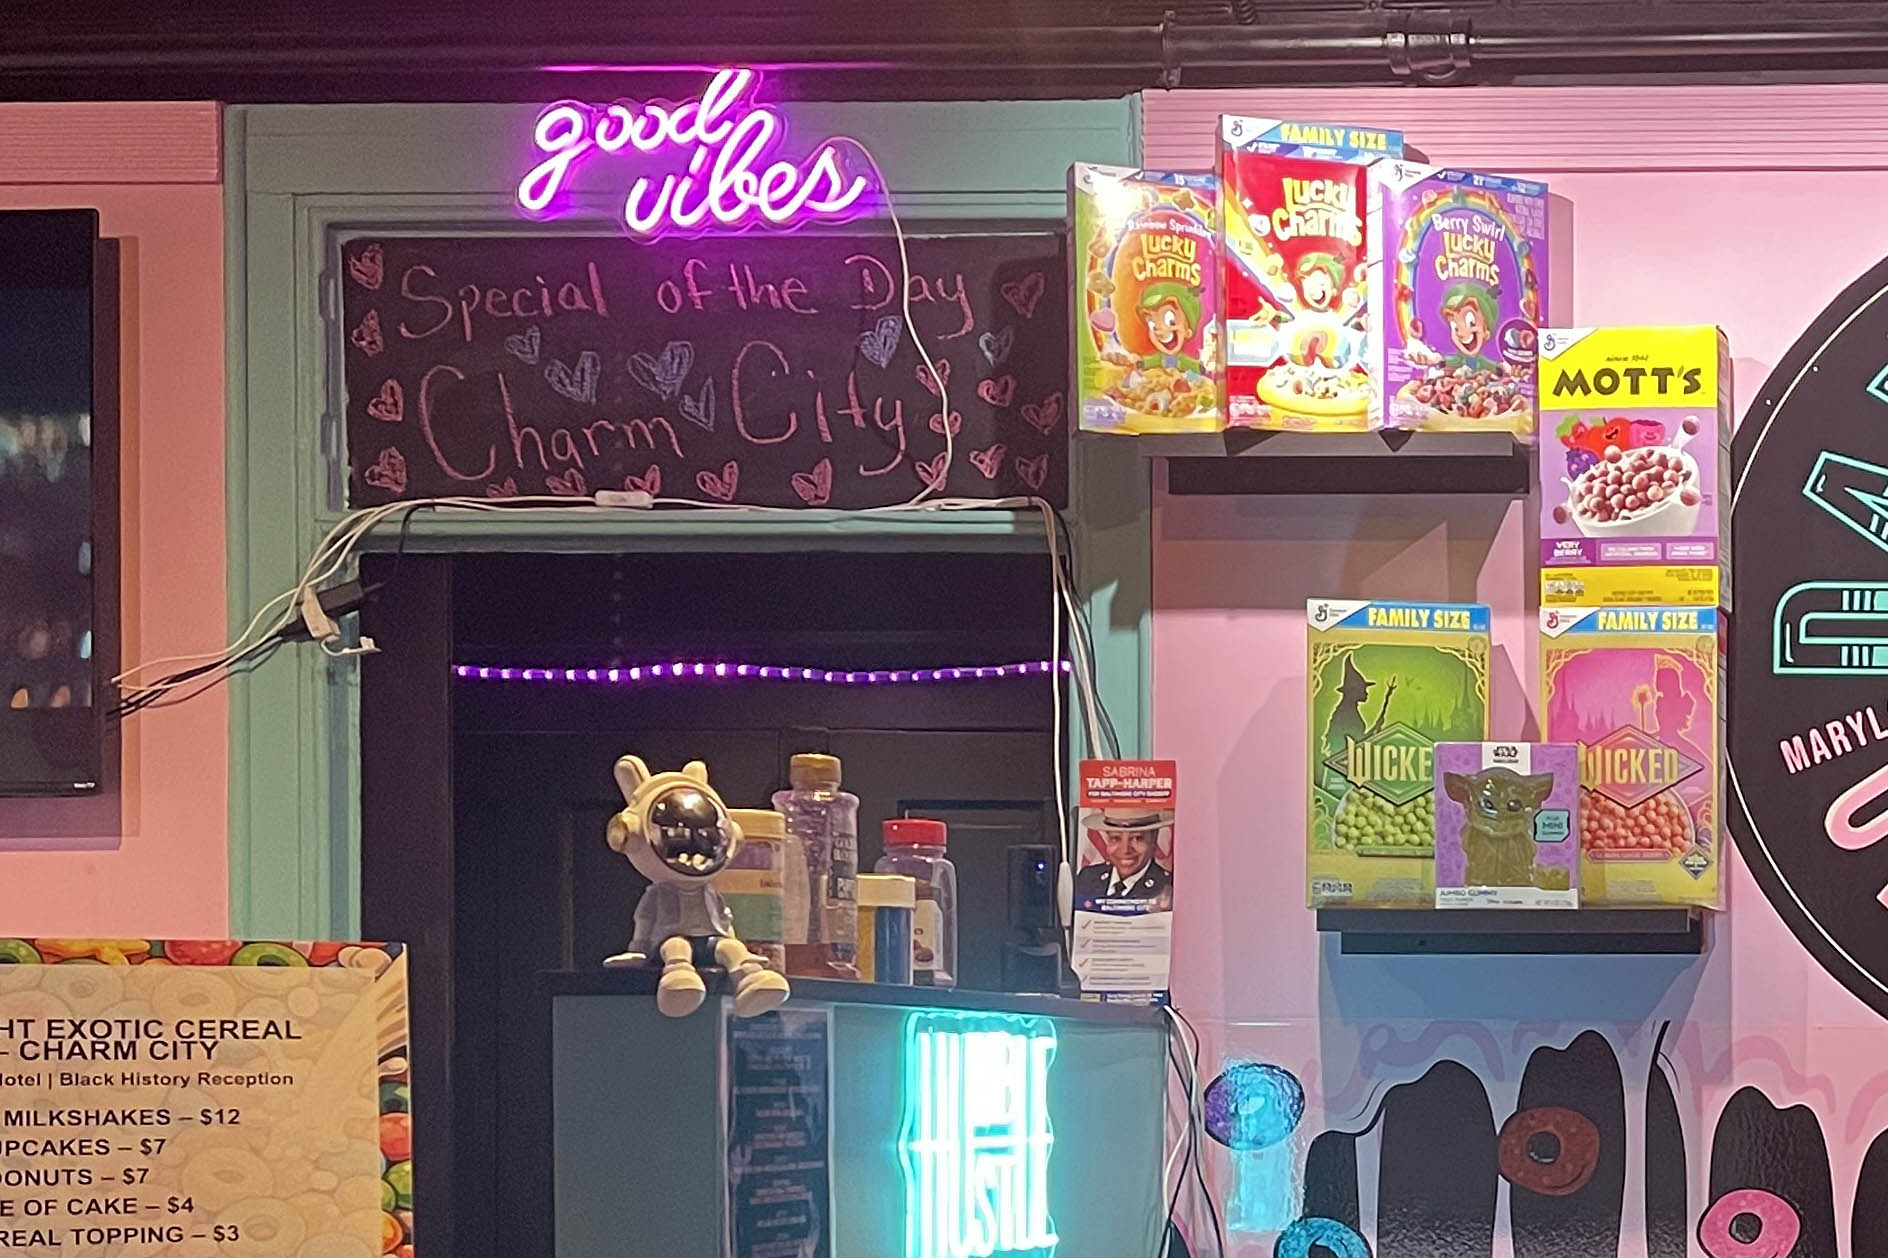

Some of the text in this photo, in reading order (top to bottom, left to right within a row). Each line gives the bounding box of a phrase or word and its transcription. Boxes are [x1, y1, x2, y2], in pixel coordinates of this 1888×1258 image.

[517, 68, 751, 211] good
[1280, 123, 1388, 151] FAMILY SIZE
[624, 110, 868, 233] vibes
[1281, 176, 1357, 213] Lucky
[1271, 206, 1363, 247] Charms
[1430, 213, 1469, 237] Berry
[1472, 214, 1506, 242] Swirl
[1139, 233, 1197, 264] Lucky
[1442, 231, 1496, 264] Lucky
[1131, 256, 1202, 287] Charms
[1434, 254, 1501, 287] Charms
[399, 253, 976, 342] Special of the Day
[1552, 365, 1702, 397] MOTT'S
[418, 340, 909, 481] Charm City
[1367, 606, 1430, 628] FAMILY
[1434, 608, 1471, 630] SIZE
[1598, 610, 1659, 631] FAMILY
[1661, 611, 1699, 631] SIZE
[1102, 766, 1156, 778] SABRINA
[1344, 735, 1434, 789] WICKE
[1577, 739, 1680, 793] WICKED
[1086, 777, 1172, 789] TAPP-HARPER
[46, 1019, 164, 1040] EXOTIC
[174, 1019, 303, 1040] CEREAL
[19, 1040, 220, 1061] CHARM CITY
[0, 1072, 42, 1087] otel
[60, 1072, 115, 1087] Black
[121, 1073, 191, 1089] History
[197, 1072, 295, 1088] Reception
[3, 1109, 241, 1127] MILKSHAKES $12
[0, 1138, 167, 1157] PCAKES $7
[122, 1168, 150, 1185] $7
[24, 1199, 58, 1216] OF
[66, 1197, 138, 1215] CAKE
[167, 1196, 195, 1214] $4
[70, 1226, 184, 1246] TOPPING
[213, 1224, 240, 1242] $3
